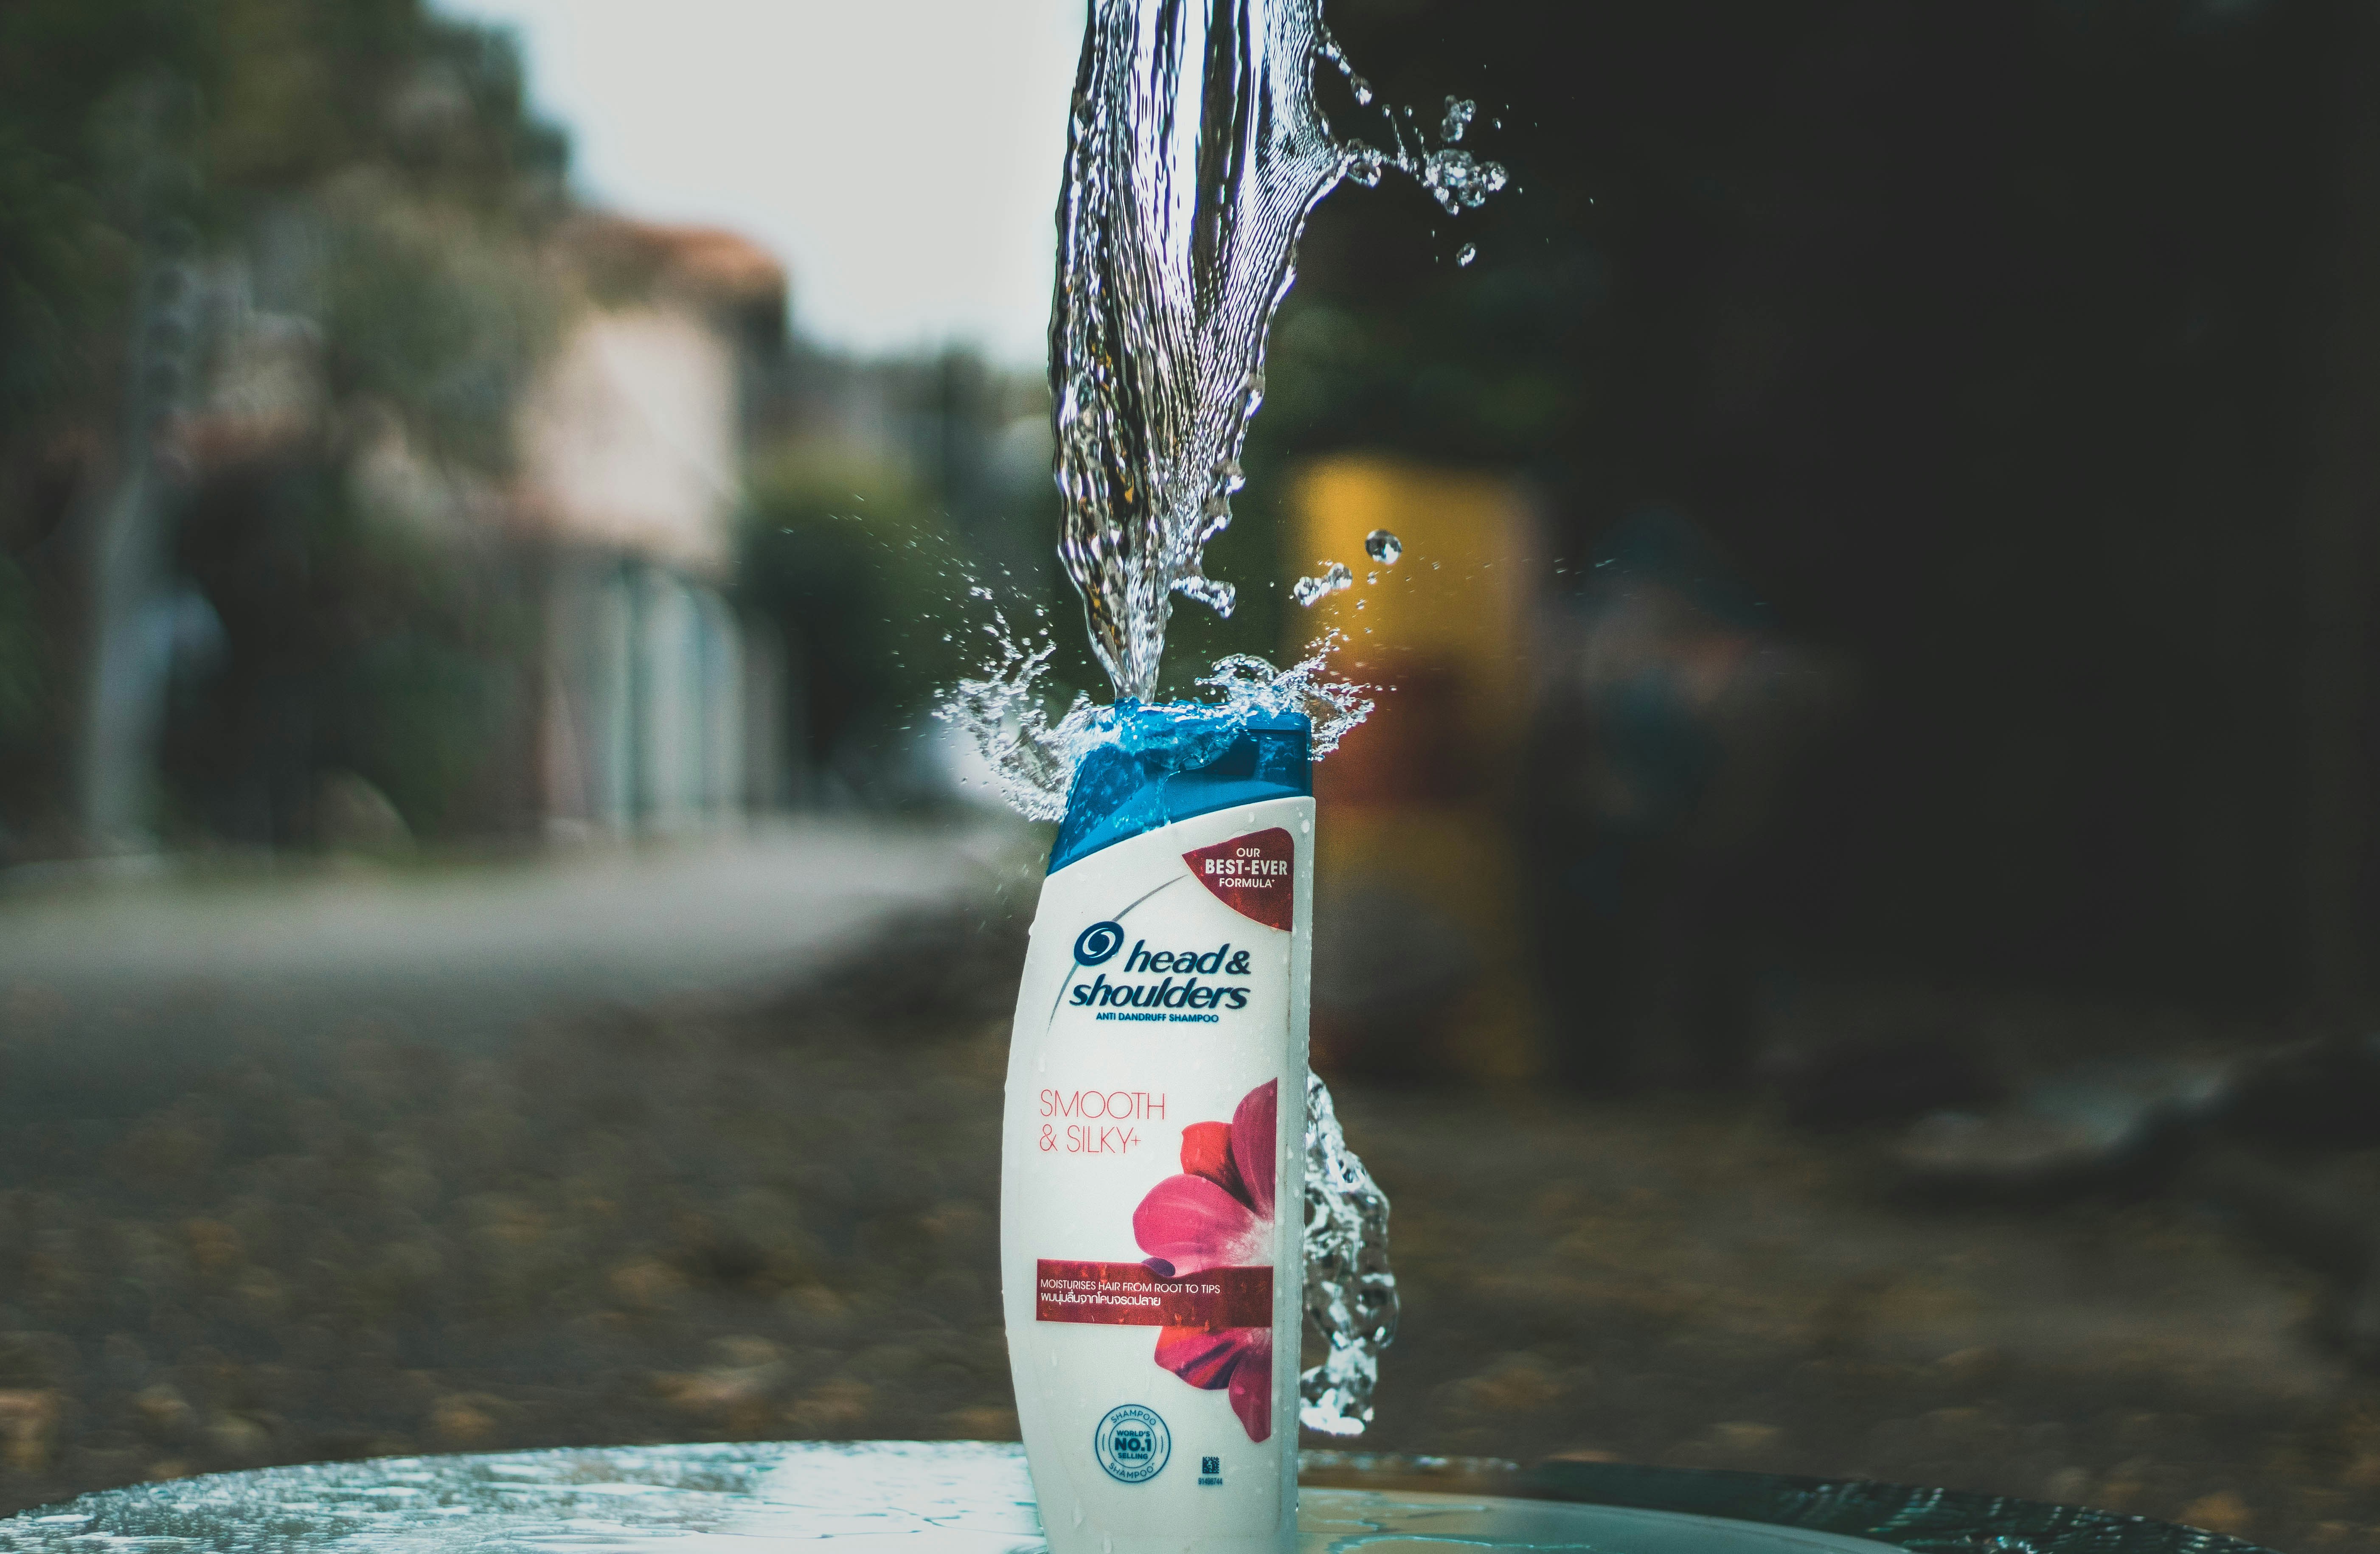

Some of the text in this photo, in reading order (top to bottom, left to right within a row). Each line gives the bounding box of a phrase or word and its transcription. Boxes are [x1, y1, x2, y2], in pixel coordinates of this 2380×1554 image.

[1236, 847, 1260, 857] OUR
[1205, 859, 1287, 875] BEST-EVER
[1124, 939, 1251, 975] head &
[1069, 973, 1251, 1009] shoulders
[1096, 1012, 1219, 1023] ANTI DANDRUFF SHAMPOO
[1040, 1089, 1165, 1120] SMOOTH
[1040, 1124, 1058, 1151] &
[1040, 1279, 1221, 1294] MOISTURISES HAIR FROM ROOT TO TIPS
[1110, 1409, 1156, 1425] SHAMPOO
[1115, 1437, 1151, 1452] NO.1
